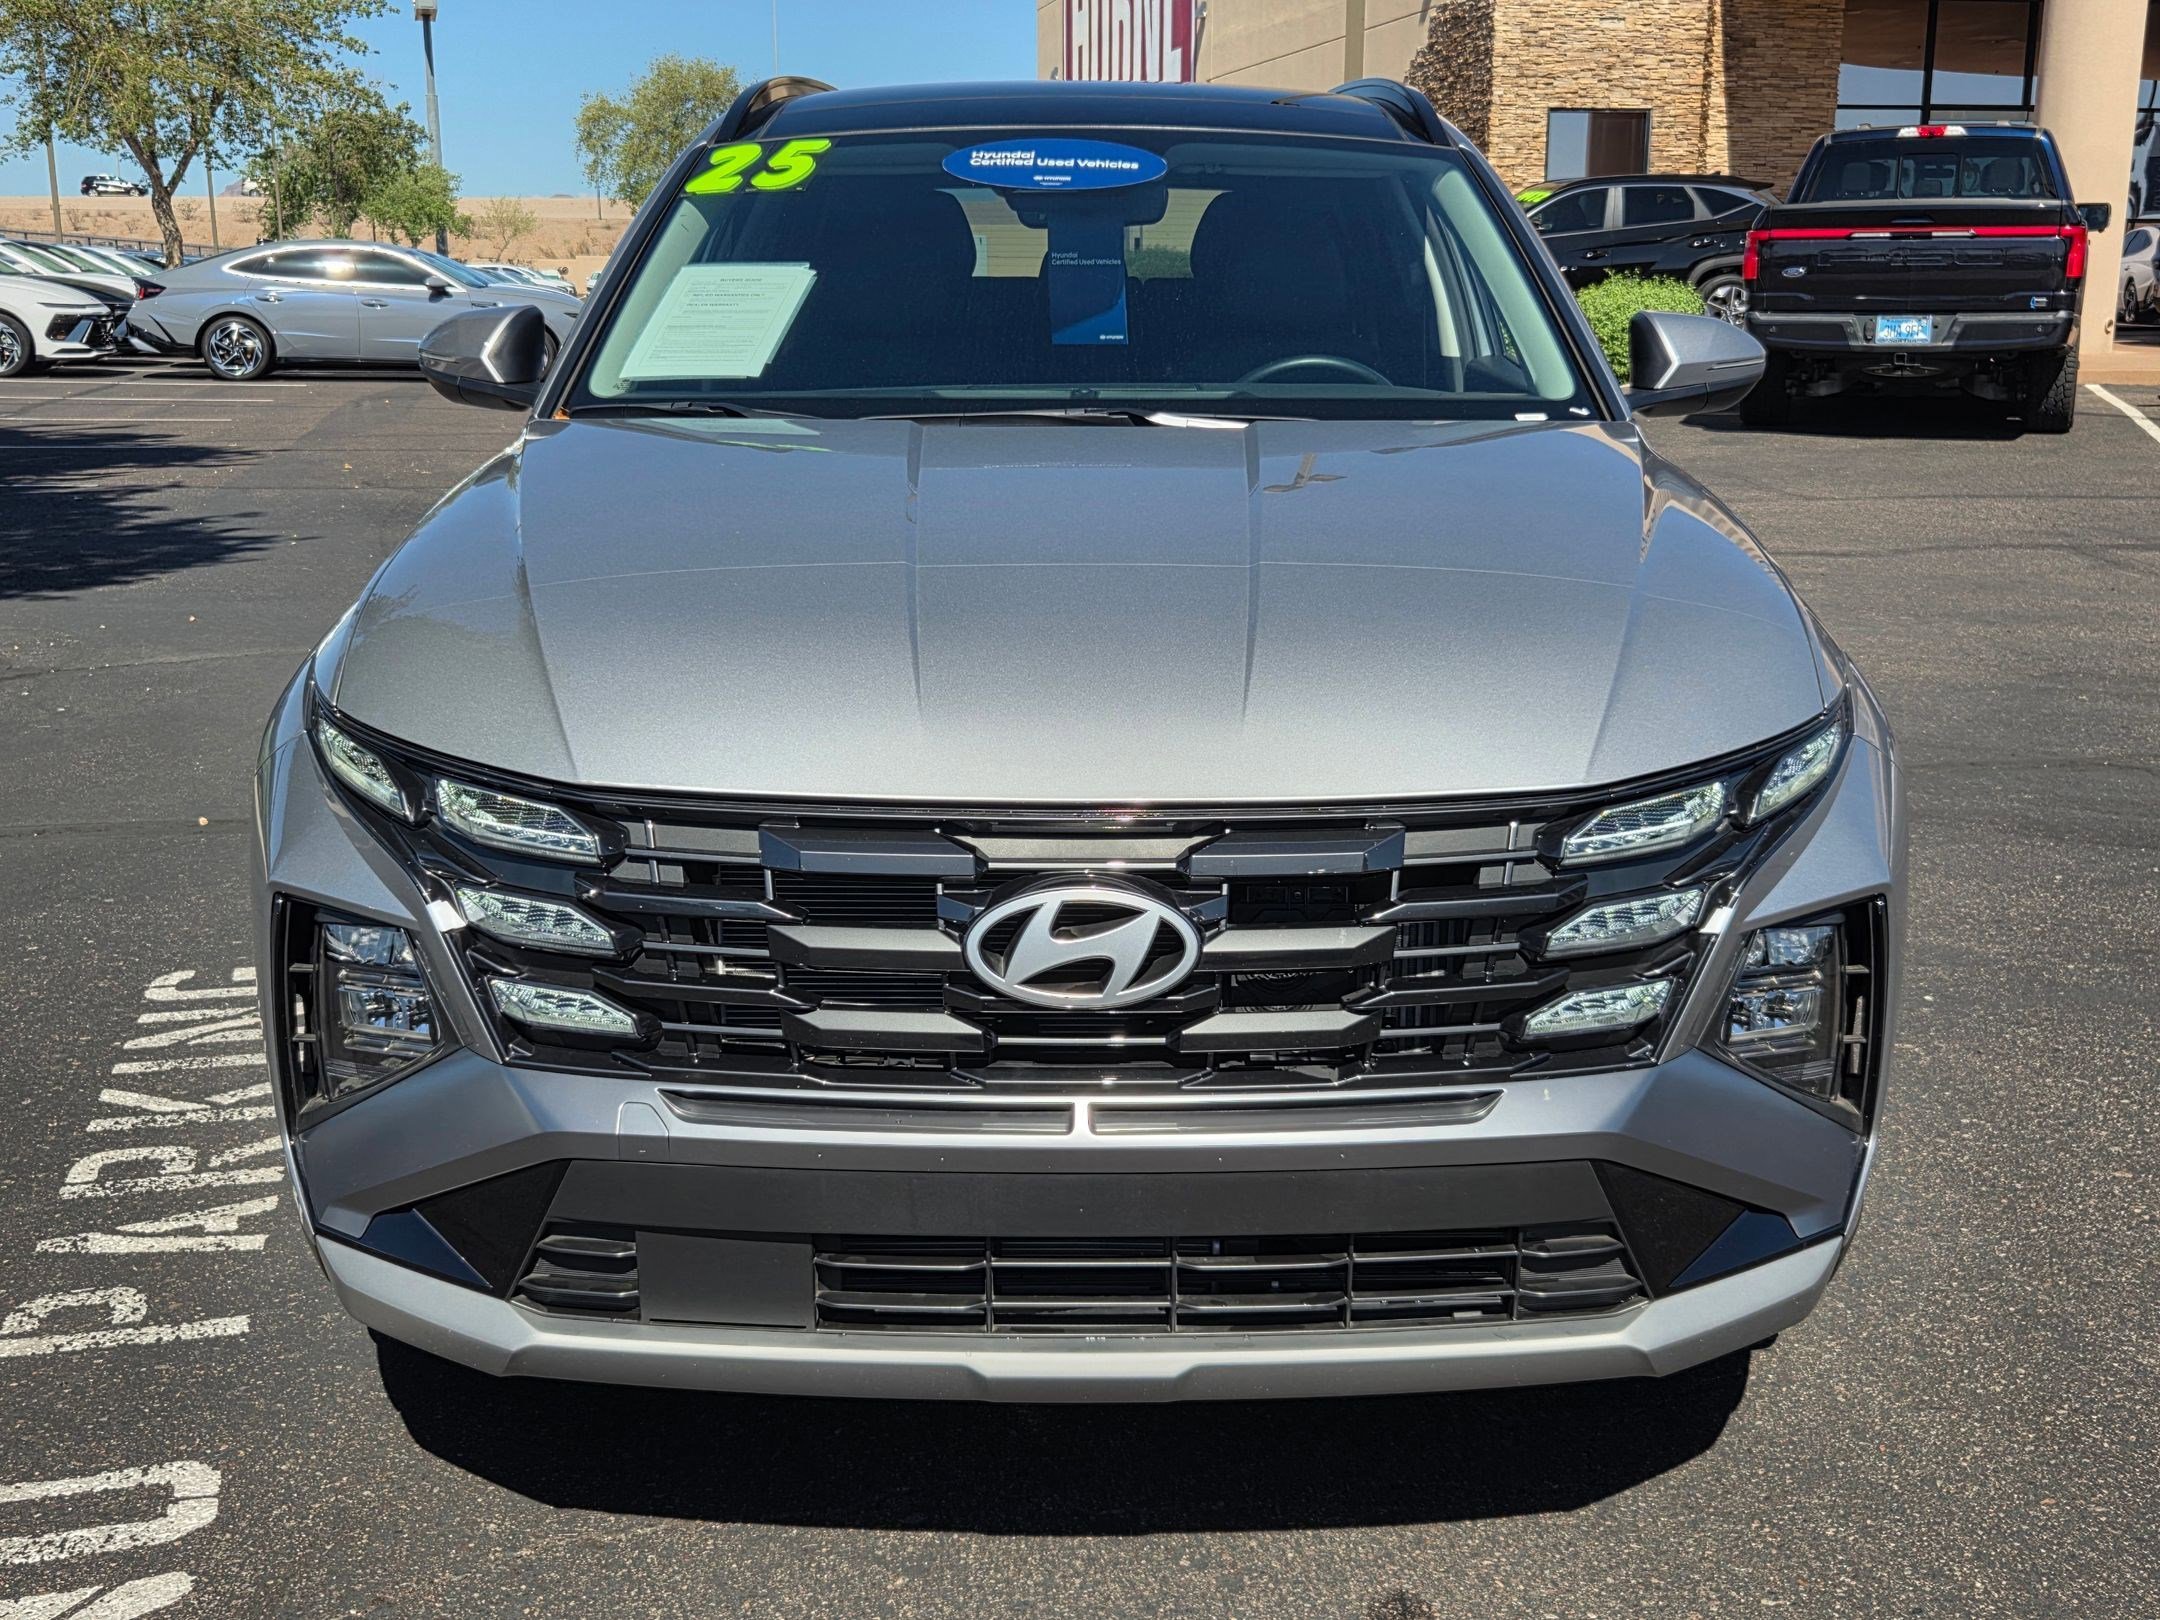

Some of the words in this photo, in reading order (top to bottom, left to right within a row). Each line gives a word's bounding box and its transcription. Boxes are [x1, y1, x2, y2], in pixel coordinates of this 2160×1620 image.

[972, 150, 1035, 160] Hyundai
[684, 138, 832, 194] 25
[969, 158, 1034, 166] Certified
[1037, 158, 1075, 167] Used
[1077, 159, 1140, 170] Vehicles
